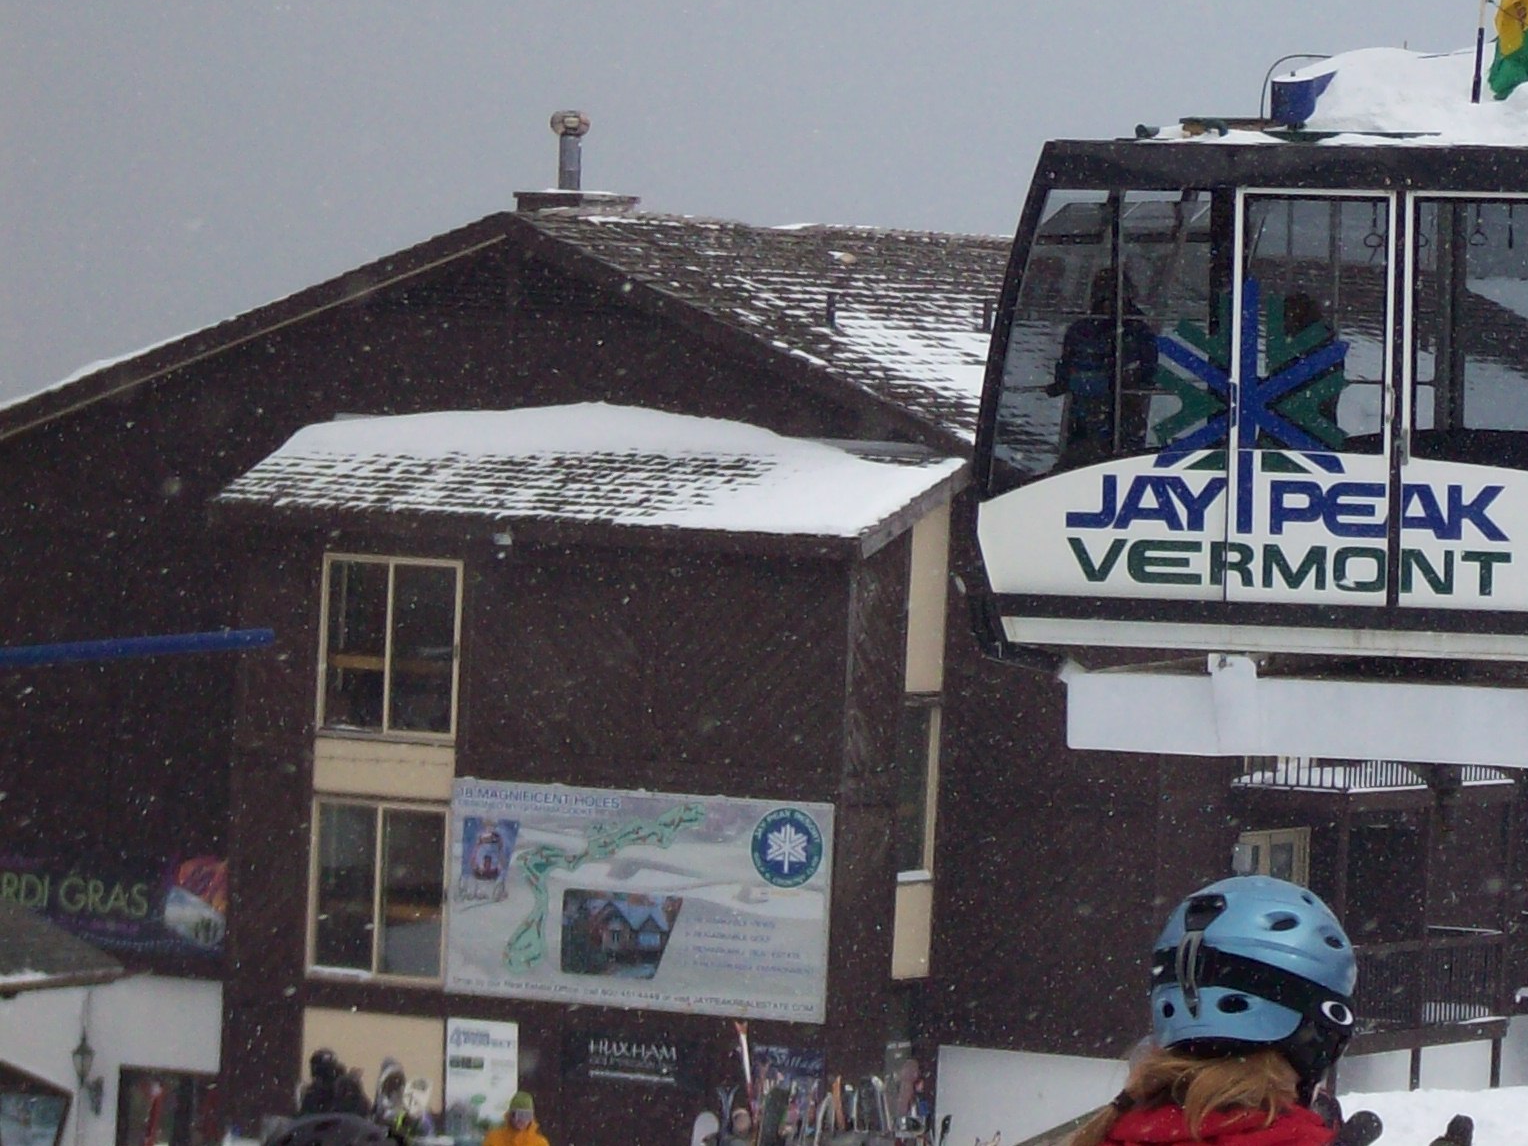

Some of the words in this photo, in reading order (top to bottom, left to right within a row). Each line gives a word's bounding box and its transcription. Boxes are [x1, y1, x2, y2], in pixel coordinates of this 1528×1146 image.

[1065, 474, 1226, 531] JAY
[1270, 480, 1509, 542] PEAK
[1067, 537, 1511, 596] VERMONT
[478, 788, 568, 805] MAGNIFICENT
[574, 795, 621, 809] HOLES
[59, 878, 149, 917] GRAS
